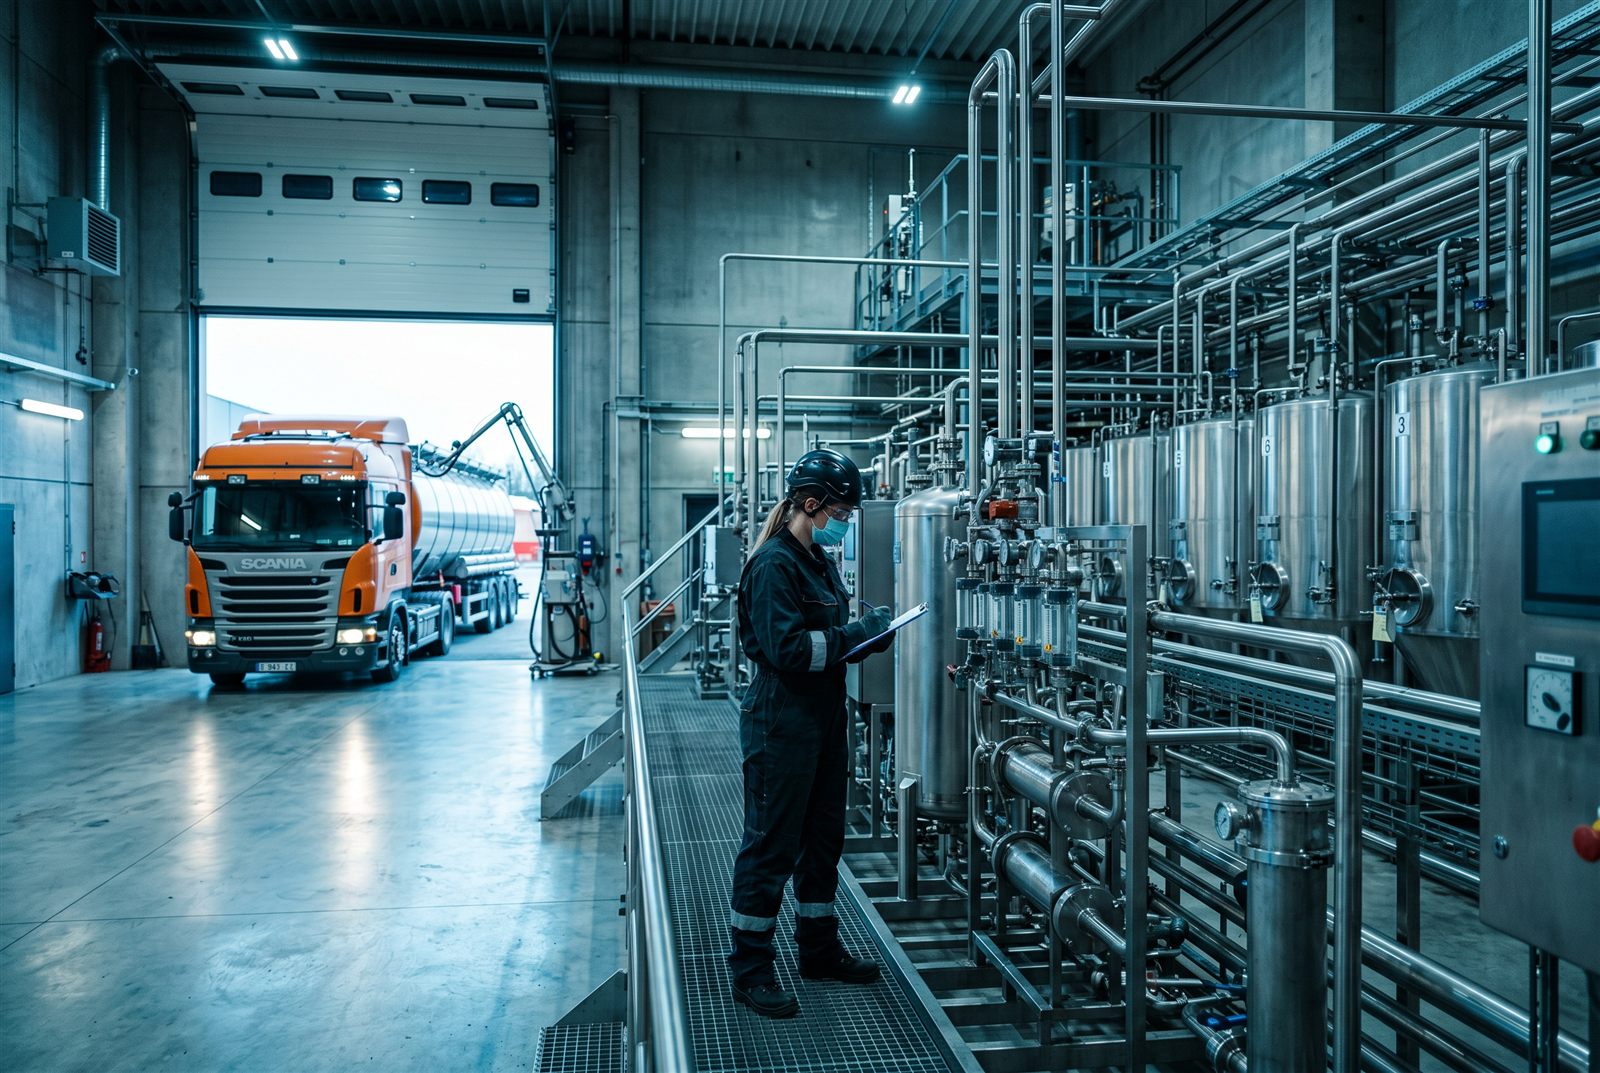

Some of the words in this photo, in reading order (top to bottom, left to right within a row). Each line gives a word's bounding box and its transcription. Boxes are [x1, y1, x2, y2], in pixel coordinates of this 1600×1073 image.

[1398, 416, 1405, 433] 3
[1265, 439, 1271, 454] 6
[240, 558, 307, 570] SCANIA
